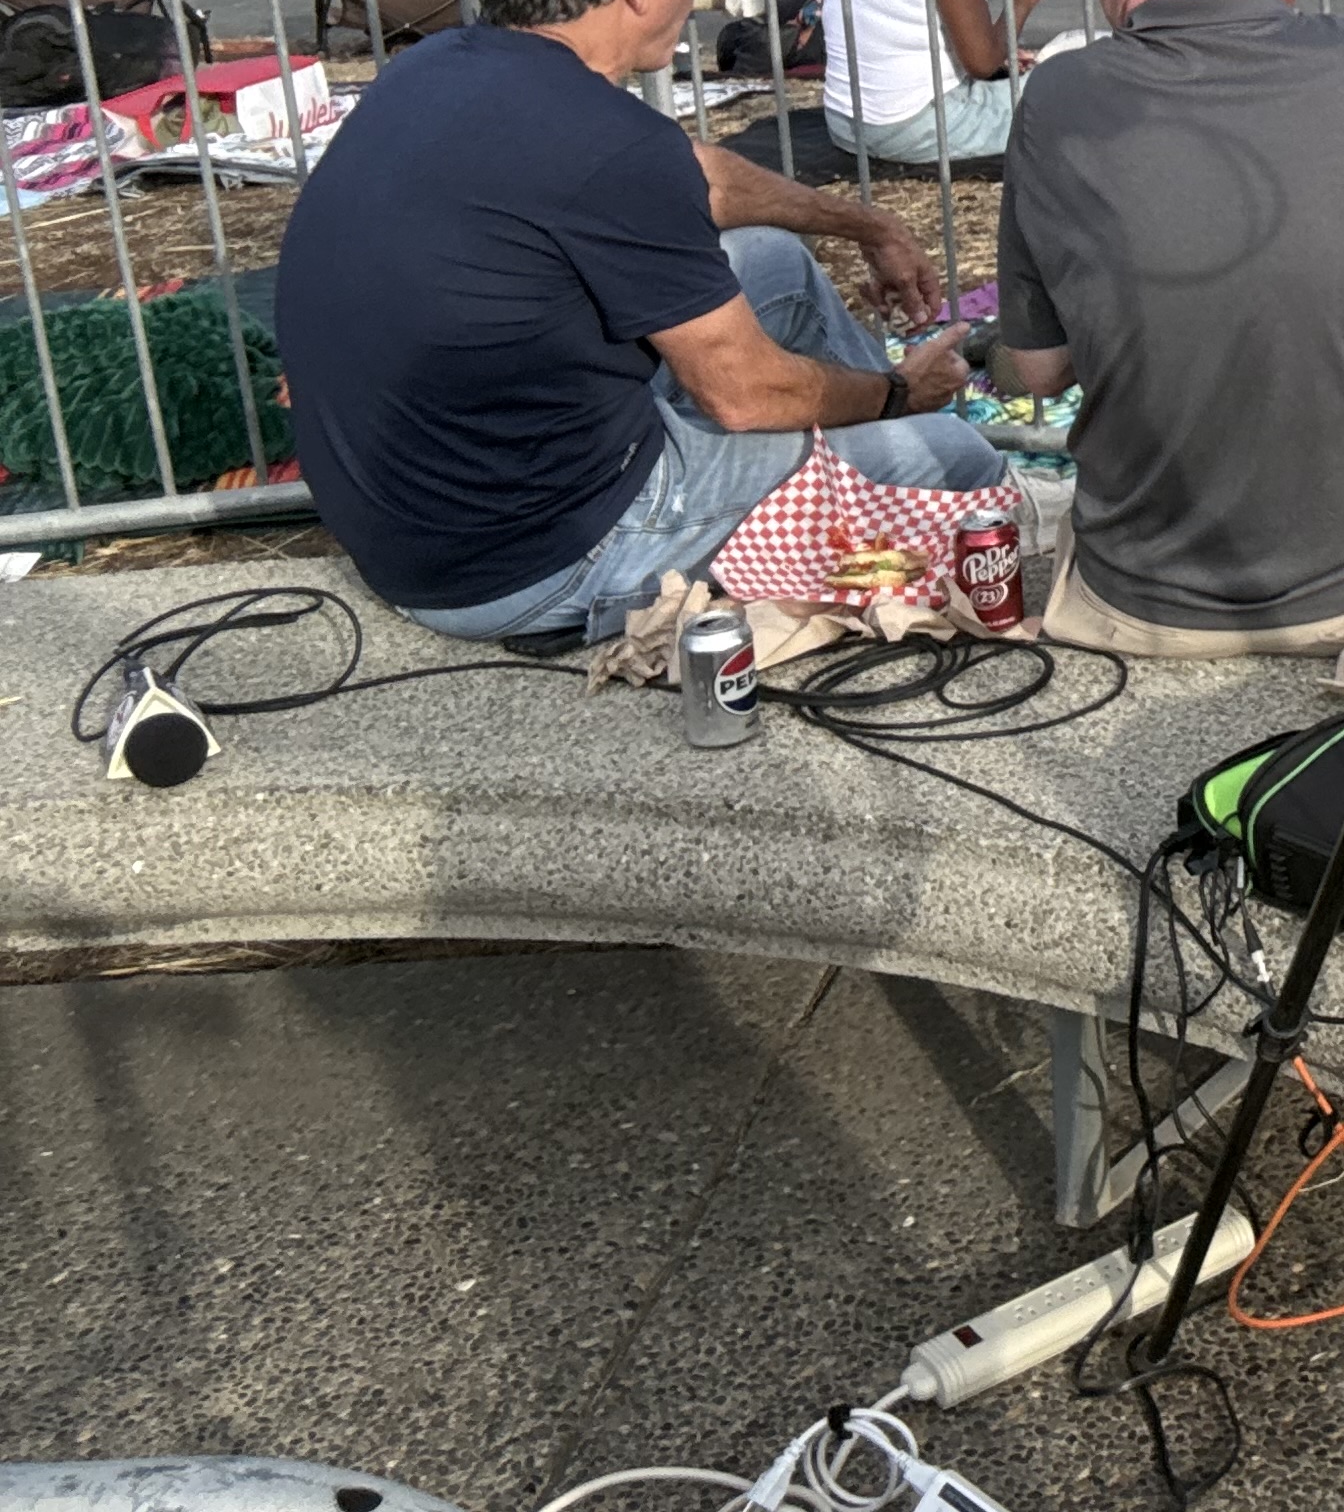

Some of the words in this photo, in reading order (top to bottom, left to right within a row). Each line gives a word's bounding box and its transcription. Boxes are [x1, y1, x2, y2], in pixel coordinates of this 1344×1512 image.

[963, 545, 1020, 584] Pepper
[985, 543, 1011, 566] Dr
[979, 590, 997, 603] 23
